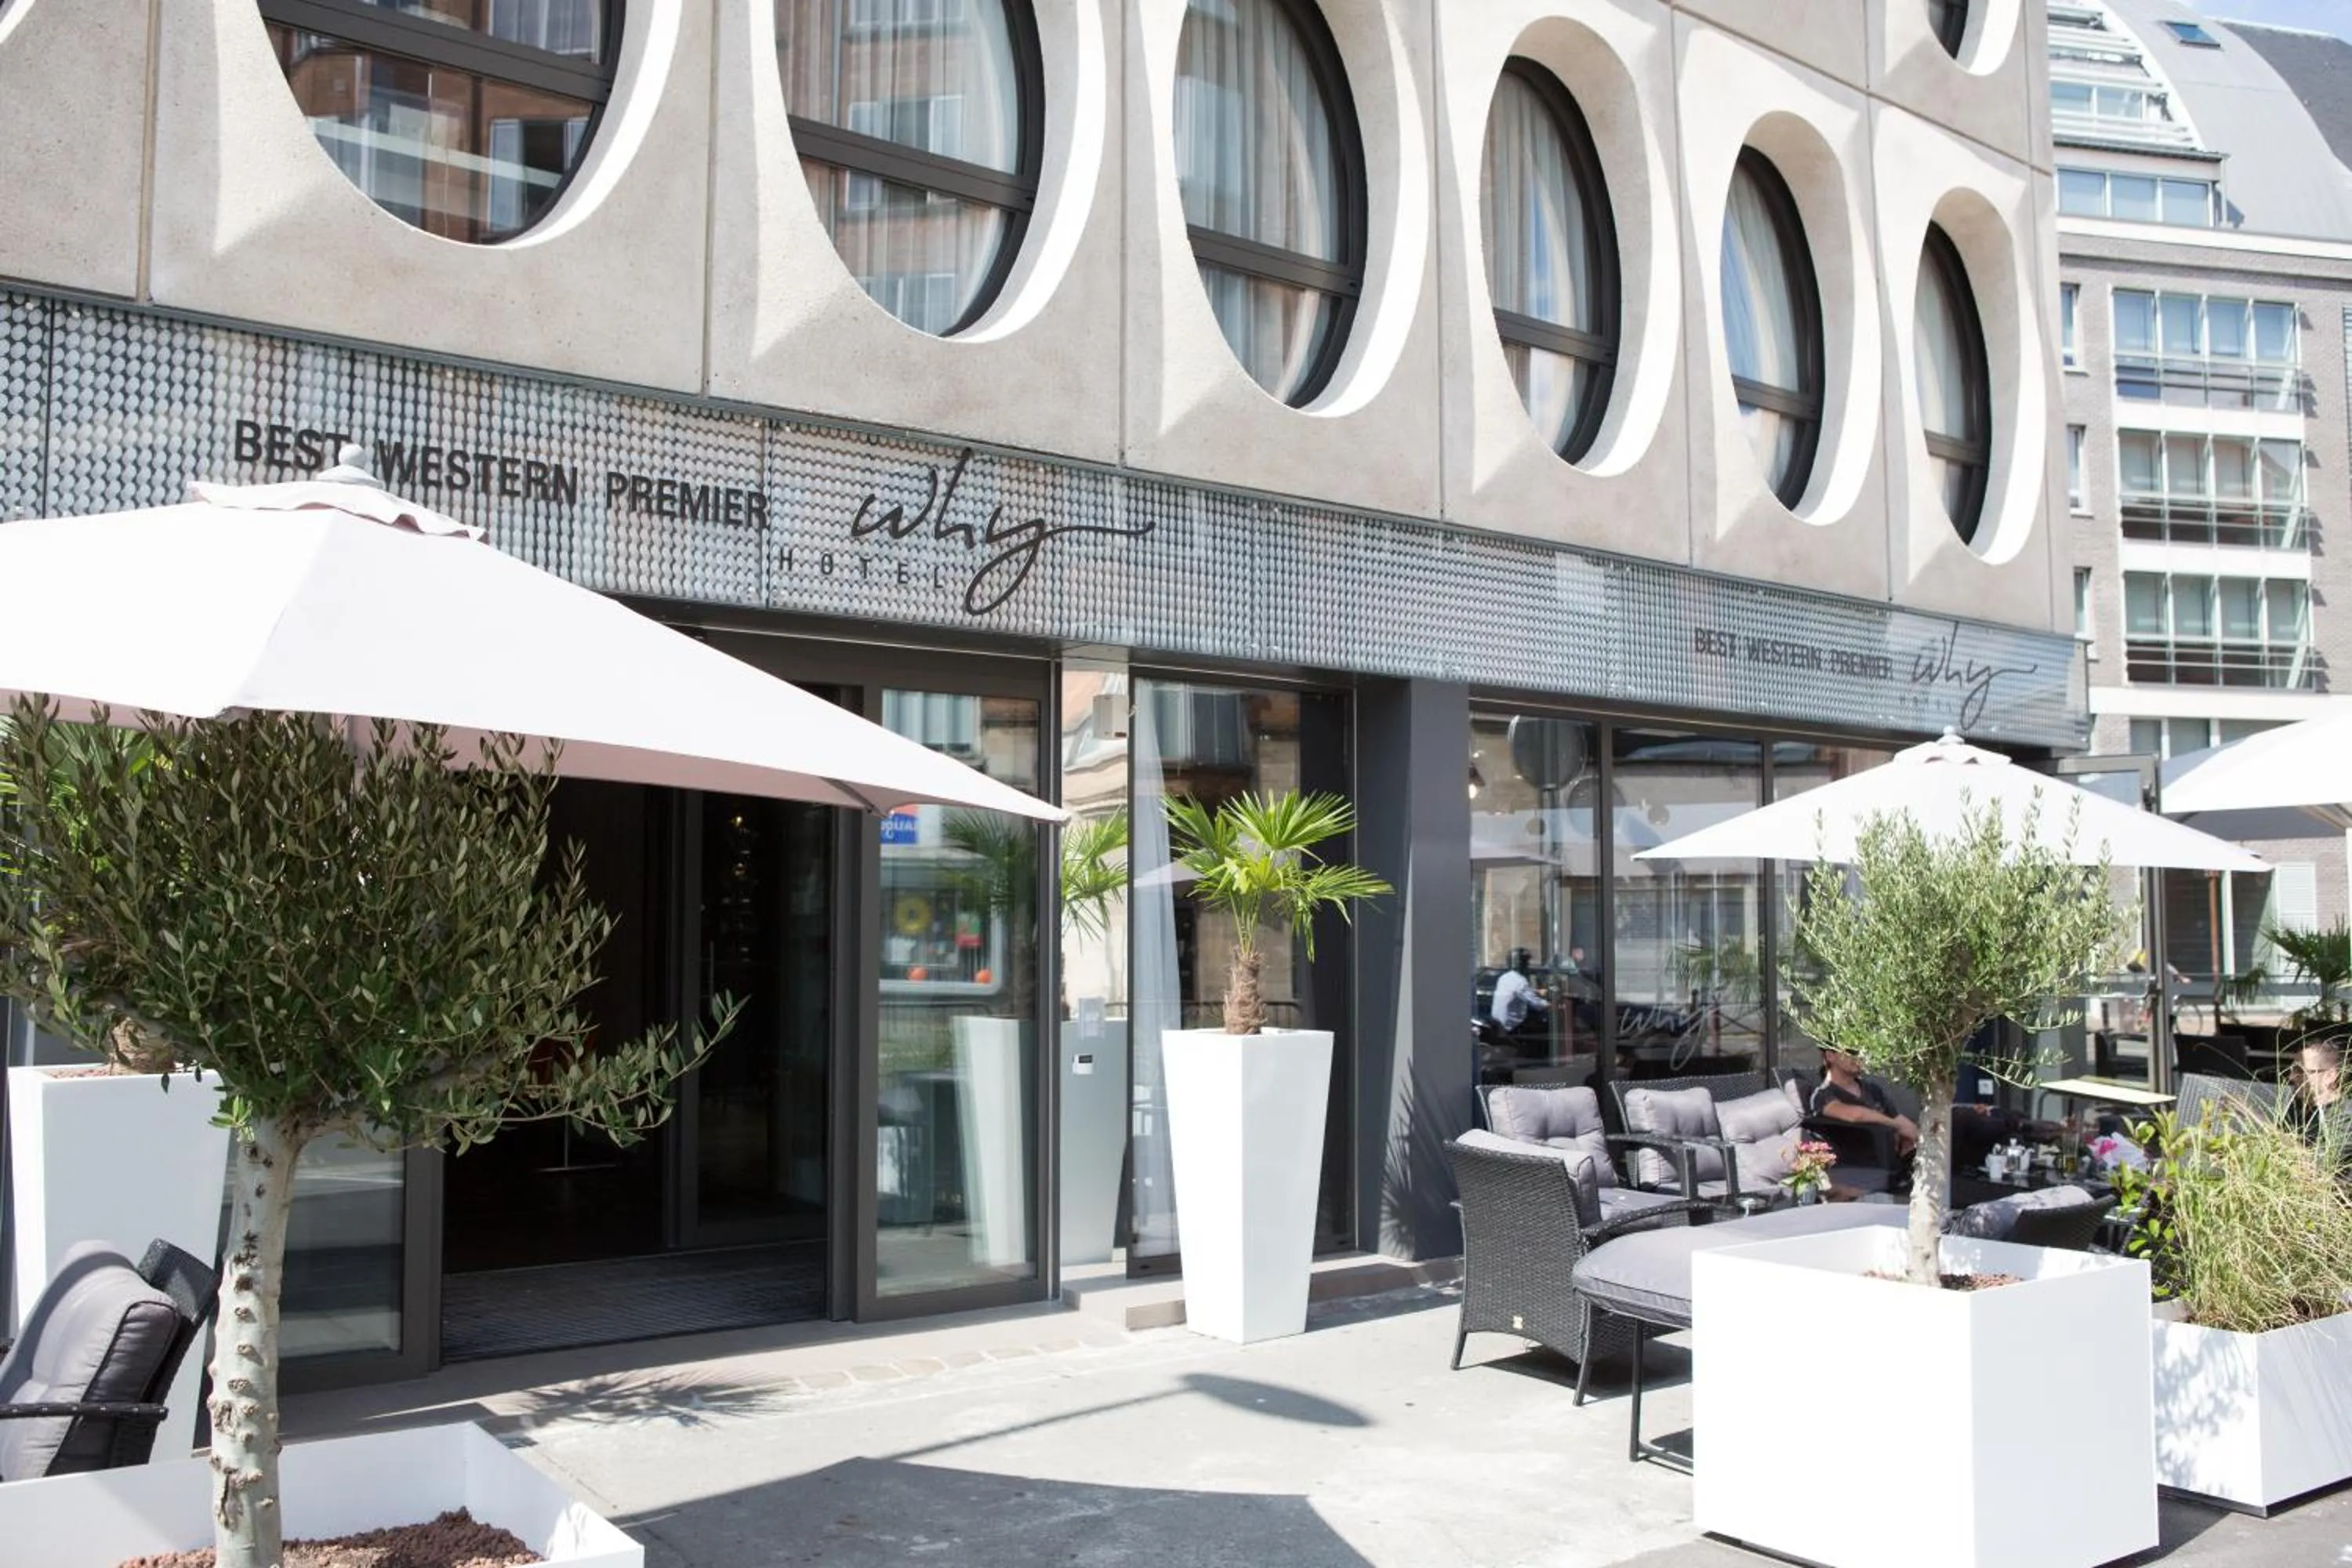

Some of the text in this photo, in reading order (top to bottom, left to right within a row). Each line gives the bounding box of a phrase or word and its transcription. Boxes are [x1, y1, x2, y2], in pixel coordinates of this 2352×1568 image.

[235, 419, 768, 528] BEST WESTERN PREMIER
[779, 550, 944, 590] HOTEL
[1694, 626, 1894, 681] BEST WESTERN PREMIER
